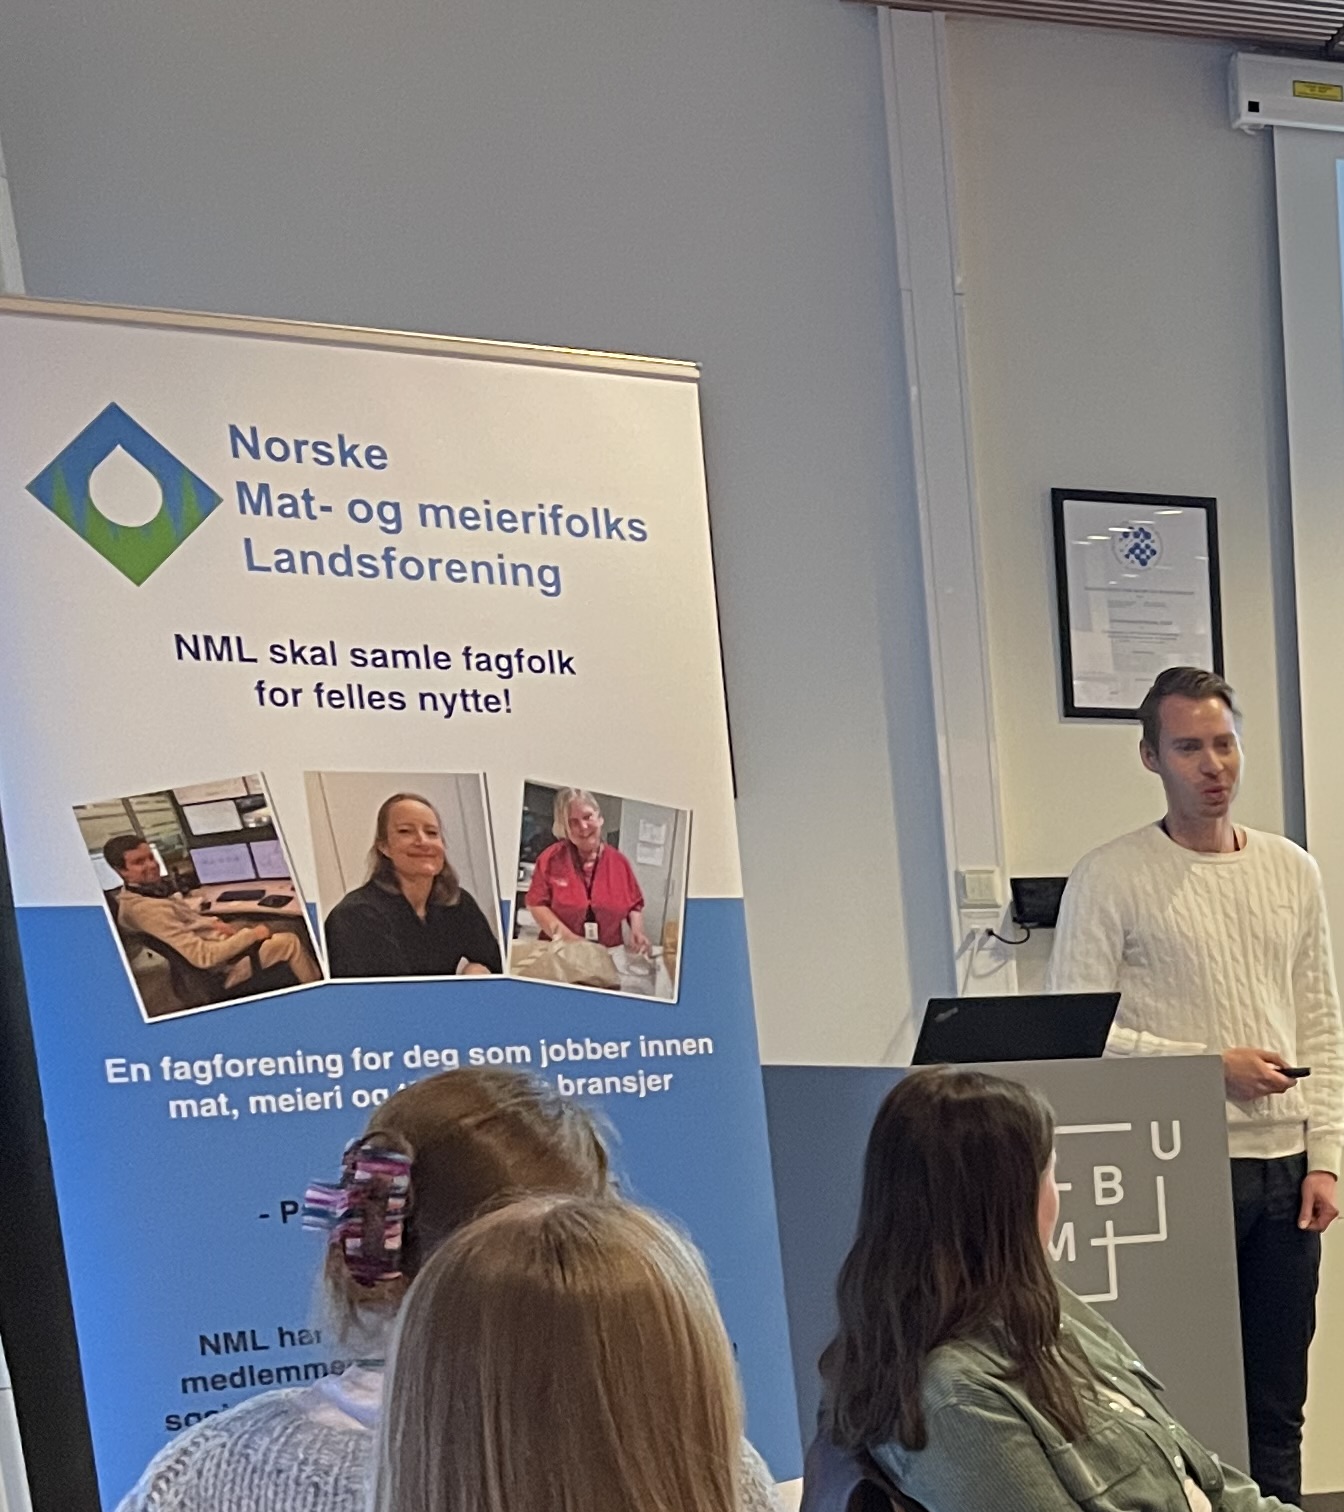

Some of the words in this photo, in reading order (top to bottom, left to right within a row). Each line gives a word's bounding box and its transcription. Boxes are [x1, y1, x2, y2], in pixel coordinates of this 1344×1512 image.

[228, 423, 390, 472] Norske
[235, 481, 334, 521] Mat-
[347, 494, 403, 536] og
[419, 498, 650, 543] meierifolks
[244, 537, 564, 597] Landsforening
[173, 633, 259, 666] NML
[269, 638, 339, 668] skal
[349, 642, 452, 672] samle
[461, 645, 577, 680] fagfolk
[254, 680, 304, 709] for
[312, 682, 407, 712] felles
[417, 688, 514, 719] nytte!
[105, 1057, 152, 1085] En
[160, 1052, 345, 1087] fagforening
[352, 1047, 395, 1073] for
[403, 1043, 459, 1074] deg
[467, 1042, 532, 1067] som
[539, 1037, 631, 1070] jobber
[639, 1033, 715, 1059] innen
[168, 1091, 240, 1122] mat,
[248, 1086, 345, 1114] meieri
[557, 1070, 675, 1102] bransjer
[199, 1328, 270, 1357] NML
